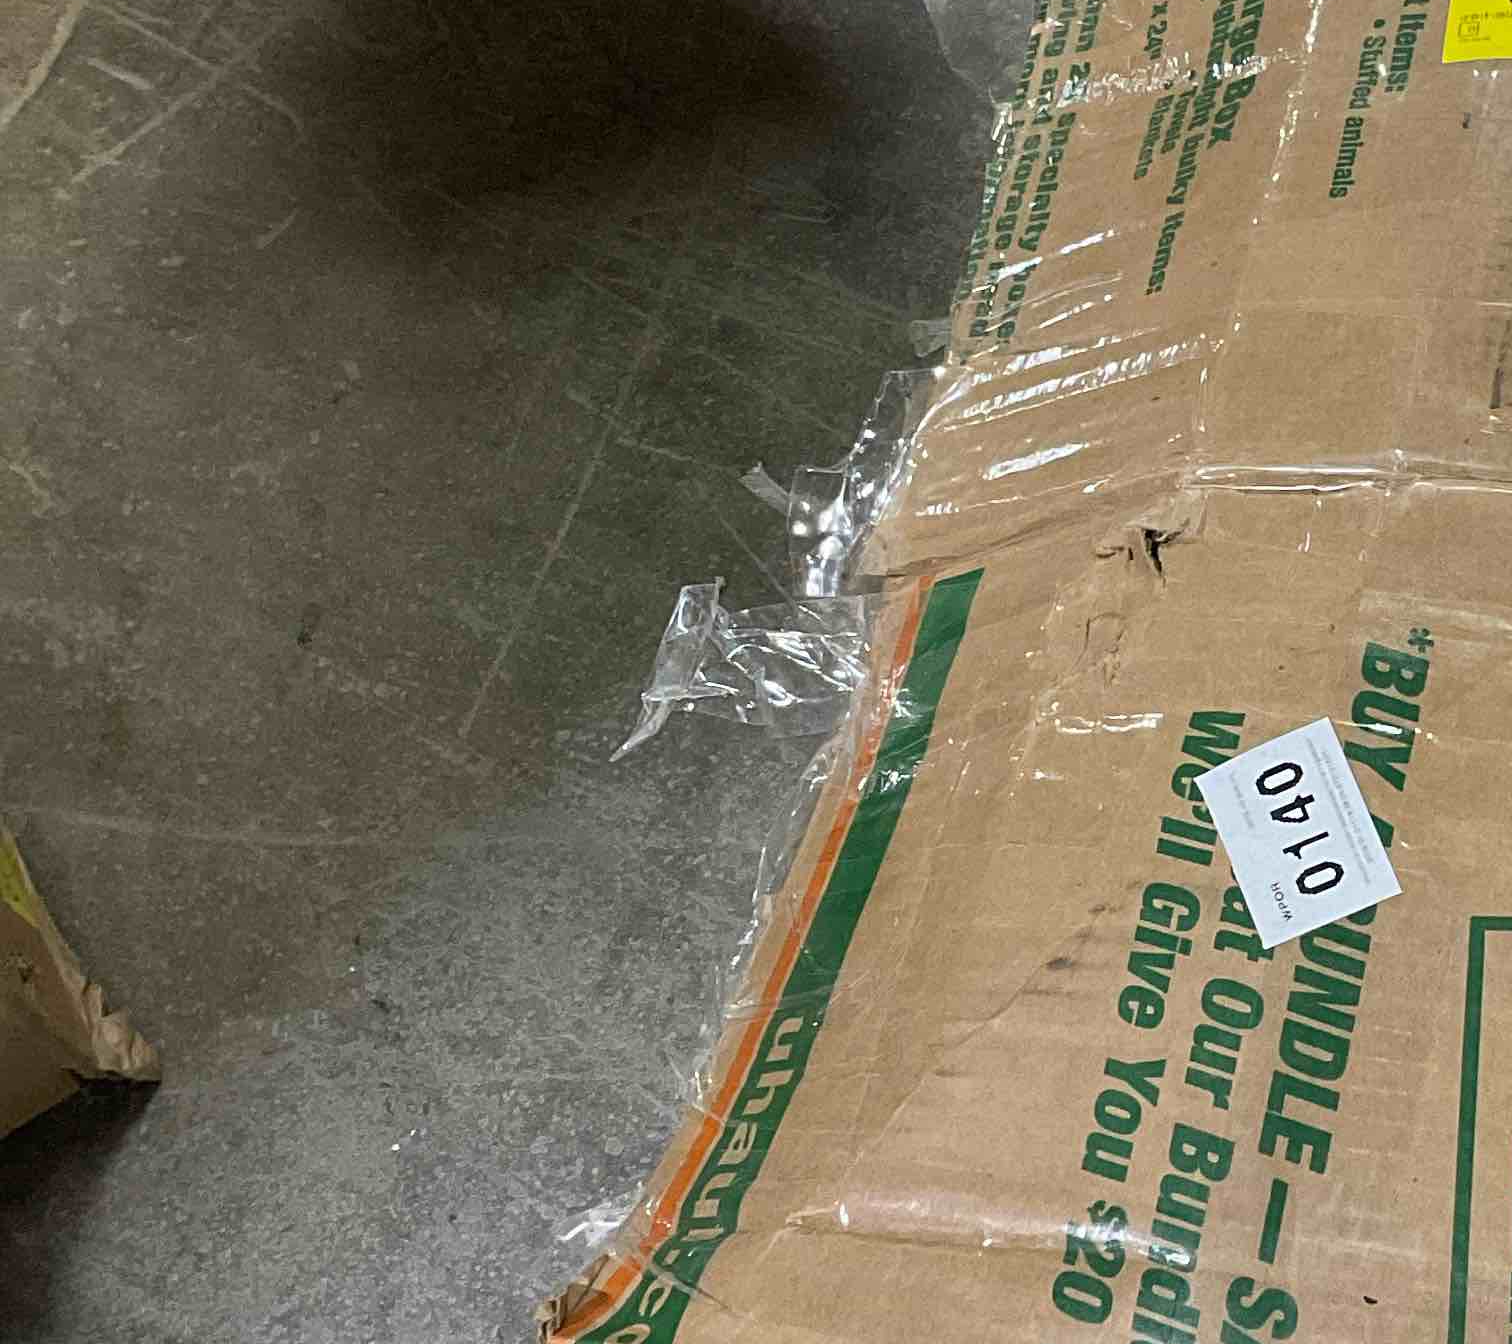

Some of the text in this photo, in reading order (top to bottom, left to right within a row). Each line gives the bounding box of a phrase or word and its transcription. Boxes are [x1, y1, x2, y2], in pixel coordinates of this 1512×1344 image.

[1207, 76, 1256, 150] Box
[1329, 36, 1387, 199] Stuffed animals
[1255, 761, 1345, 896] 0140
[1117, 881, 1201, 1031] Give
[1182, 976, 1264, 1114] Our
[1081, 1057, 1168, 1184] You
[1050, 1198, 1134, 1327] $20
